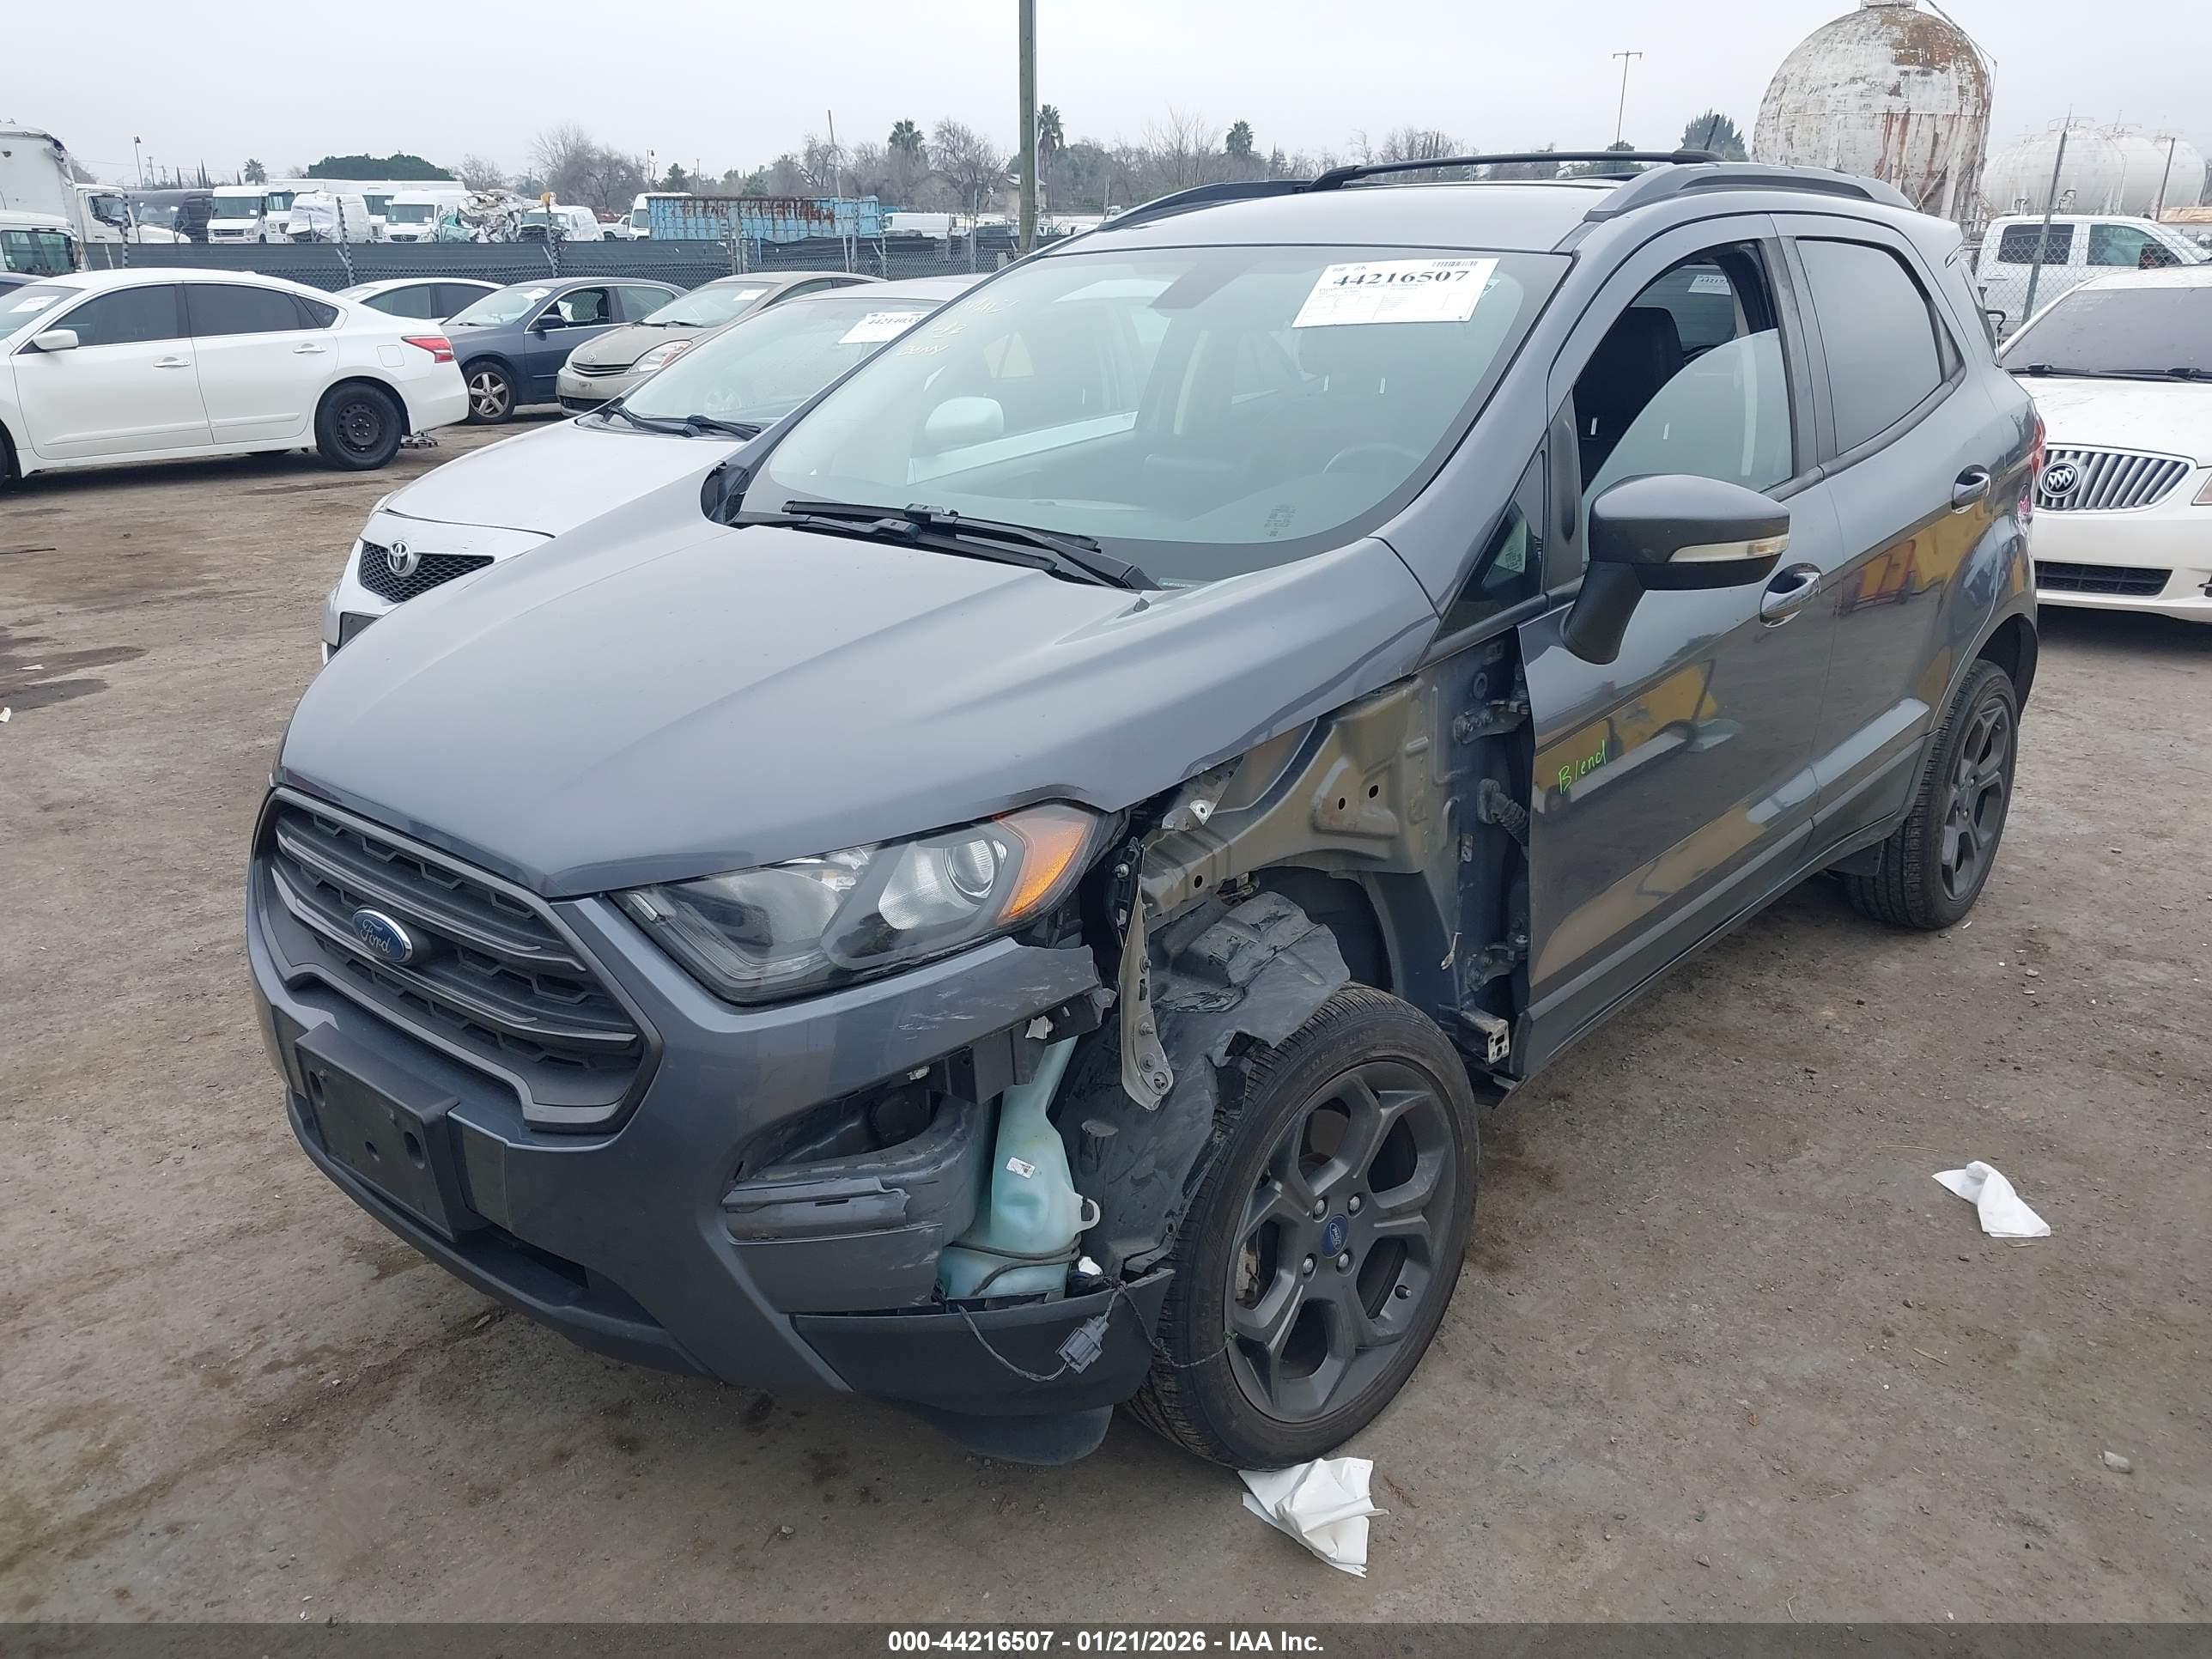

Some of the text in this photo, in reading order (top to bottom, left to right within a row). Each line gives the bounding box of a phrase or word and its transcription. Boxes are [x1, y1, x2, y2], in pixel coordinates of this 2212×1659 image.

[1333, 270, 1470, 286] 44216507
[1559, 739, 1607, 795] Blend
[360, 919, 392, 953] Ford
